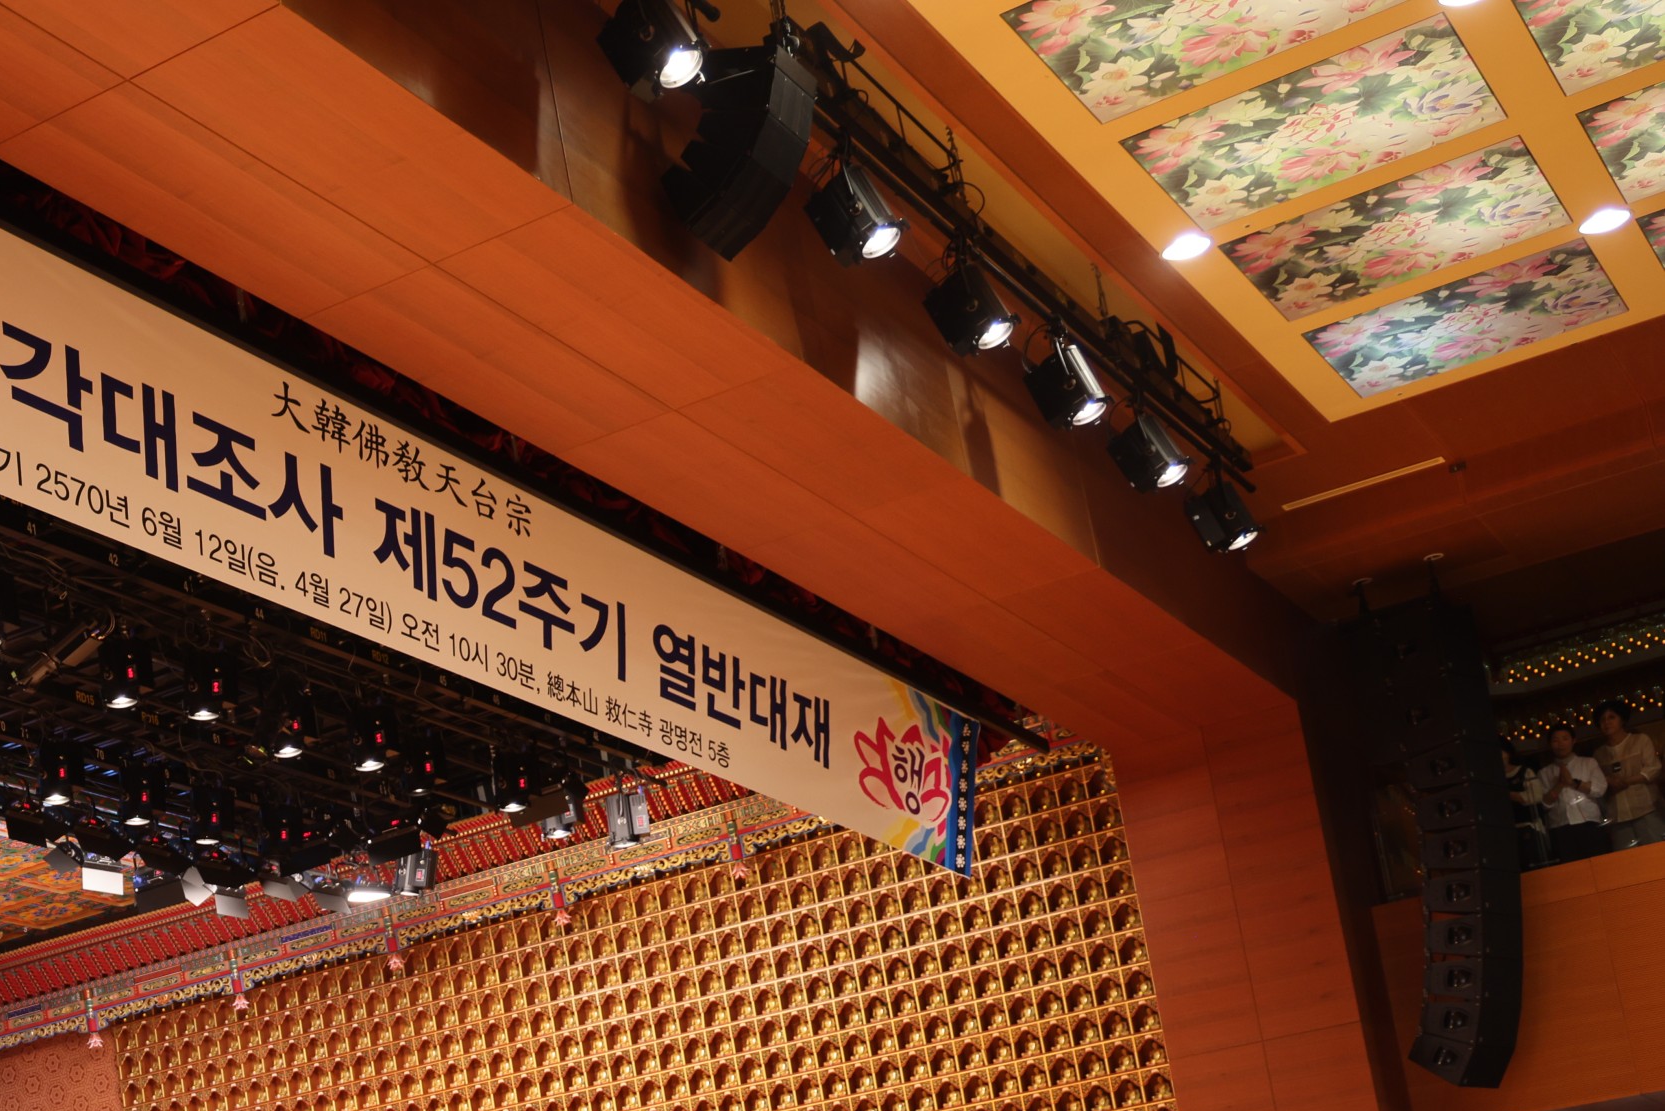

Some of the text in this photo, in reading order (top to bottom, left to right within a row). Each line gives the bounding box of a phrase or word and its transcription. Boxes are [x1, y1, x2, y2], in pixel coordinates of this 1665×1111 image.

[271, 381, 532, 538] 大韓佛敎天台宗
[35, 462, 131, 529] 2570년
[141, 506, 183, 550] 6월
[194, 528, 286, 591] 12일(음.
[294, 571, 331, 609] 4월
[338, 587, 393, 634] 27일)
[400, 612, 441, 652] 오전
[448, 632, 489, 673] 10시
[495, 651, 541, 695] 30분,
[546, 671, 599, 716] 總本山
[604, 695, 654, 738] 救仁寺
[658, 717, 703, 759] 광명전
[708, 740, 732, 769] 5층
[107, 552, 120, 568] 42
[373, 497, 627, 683] 제52주기
[652, 624, 830, 770] 열반대재
[891, 744, 926, 816] 행
